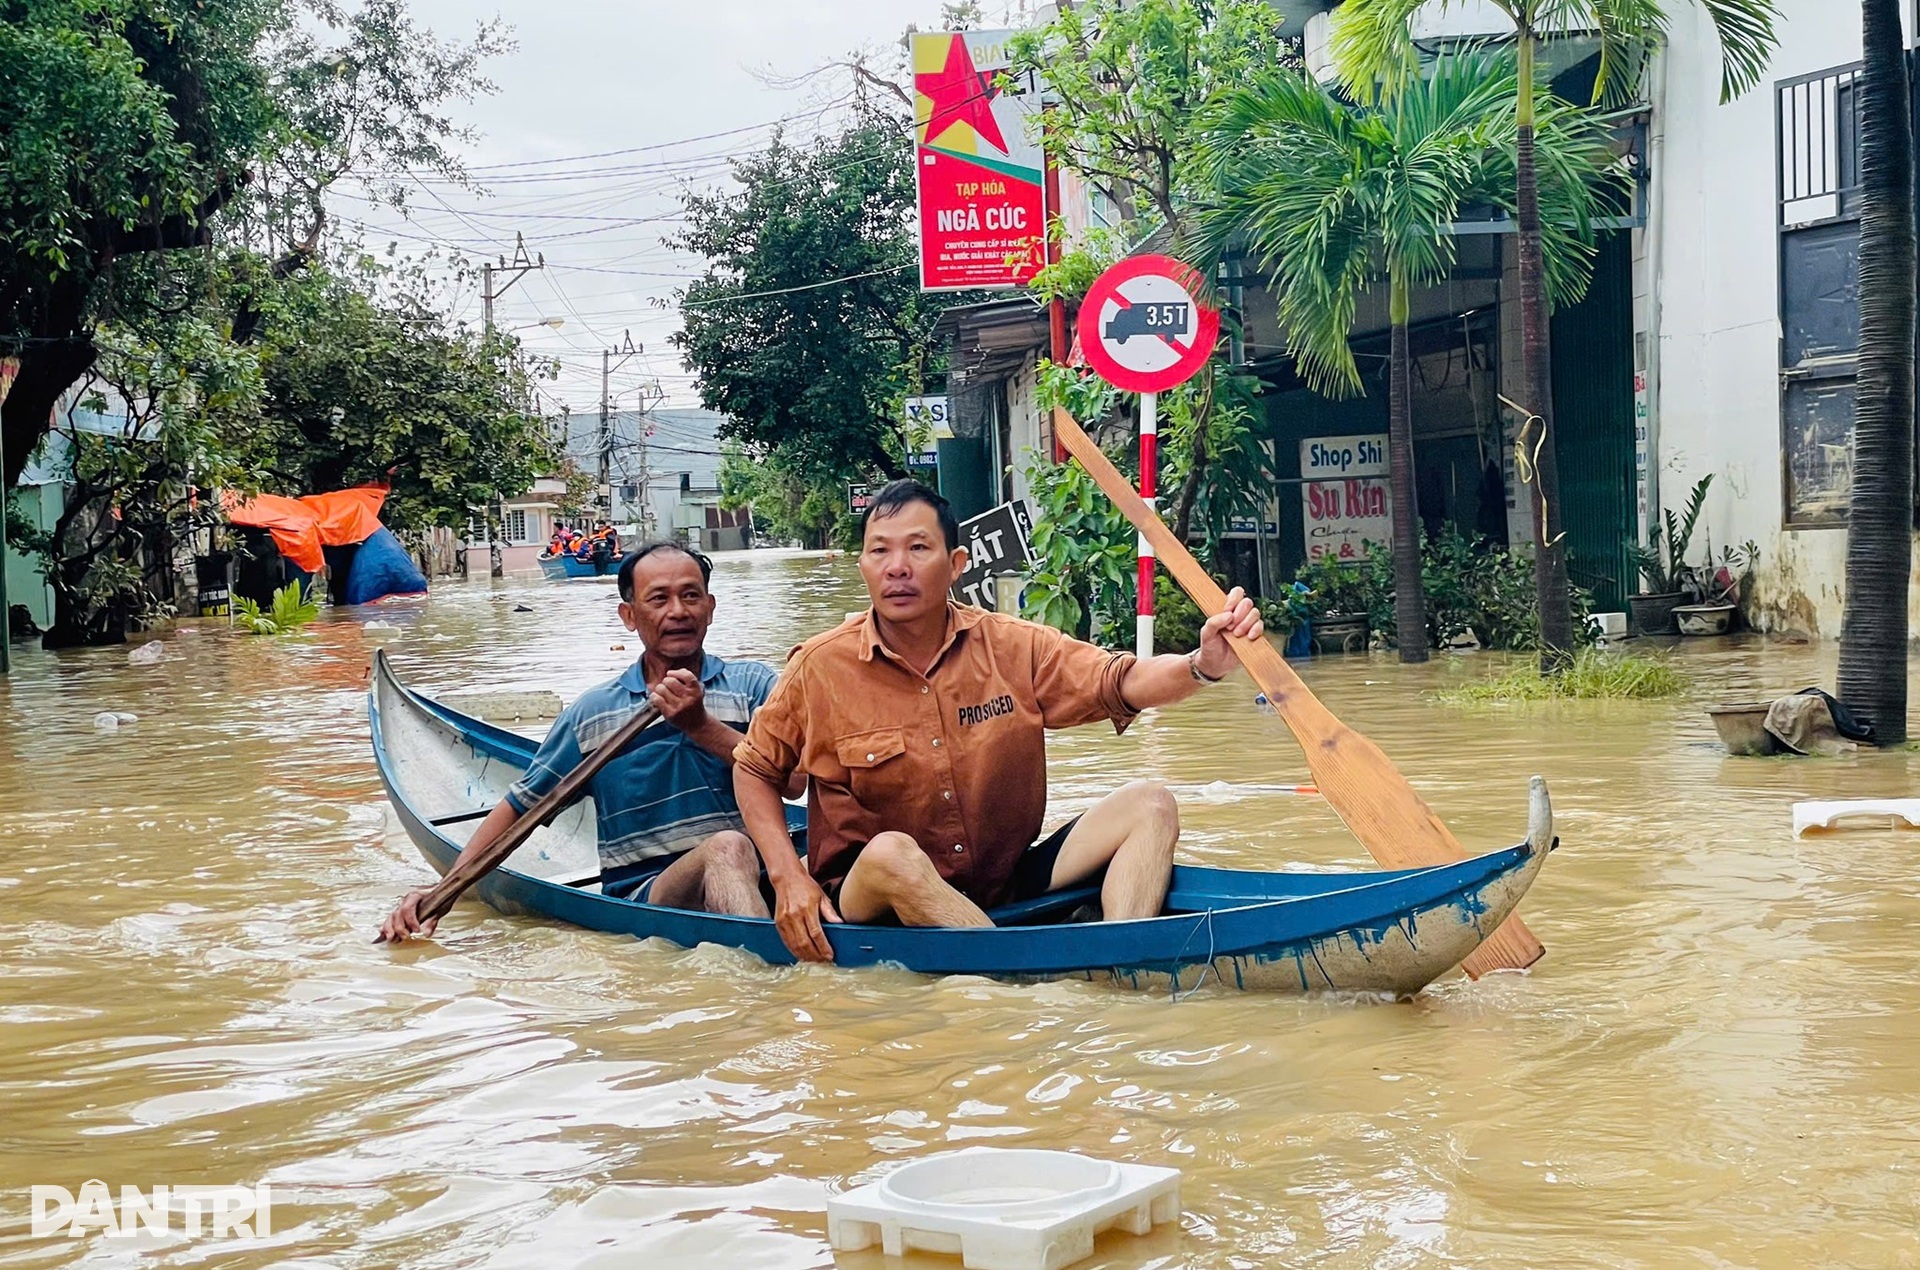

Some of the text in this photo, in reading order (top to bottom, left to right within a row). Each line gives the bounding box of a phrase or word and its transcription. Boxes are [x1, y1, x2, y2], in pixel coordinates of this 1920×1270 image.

[973, 44, 1003, 65] BIA
[956, 179, 1006, 200] TẠP HÓA
[938, 202, 1027, 232] NGÃ CÚC
[1146, 305, 1187, 326] 3,5T
[1310, 440, 1382, 472] Shop Shi
[1339, 543, 1355, 558] &
